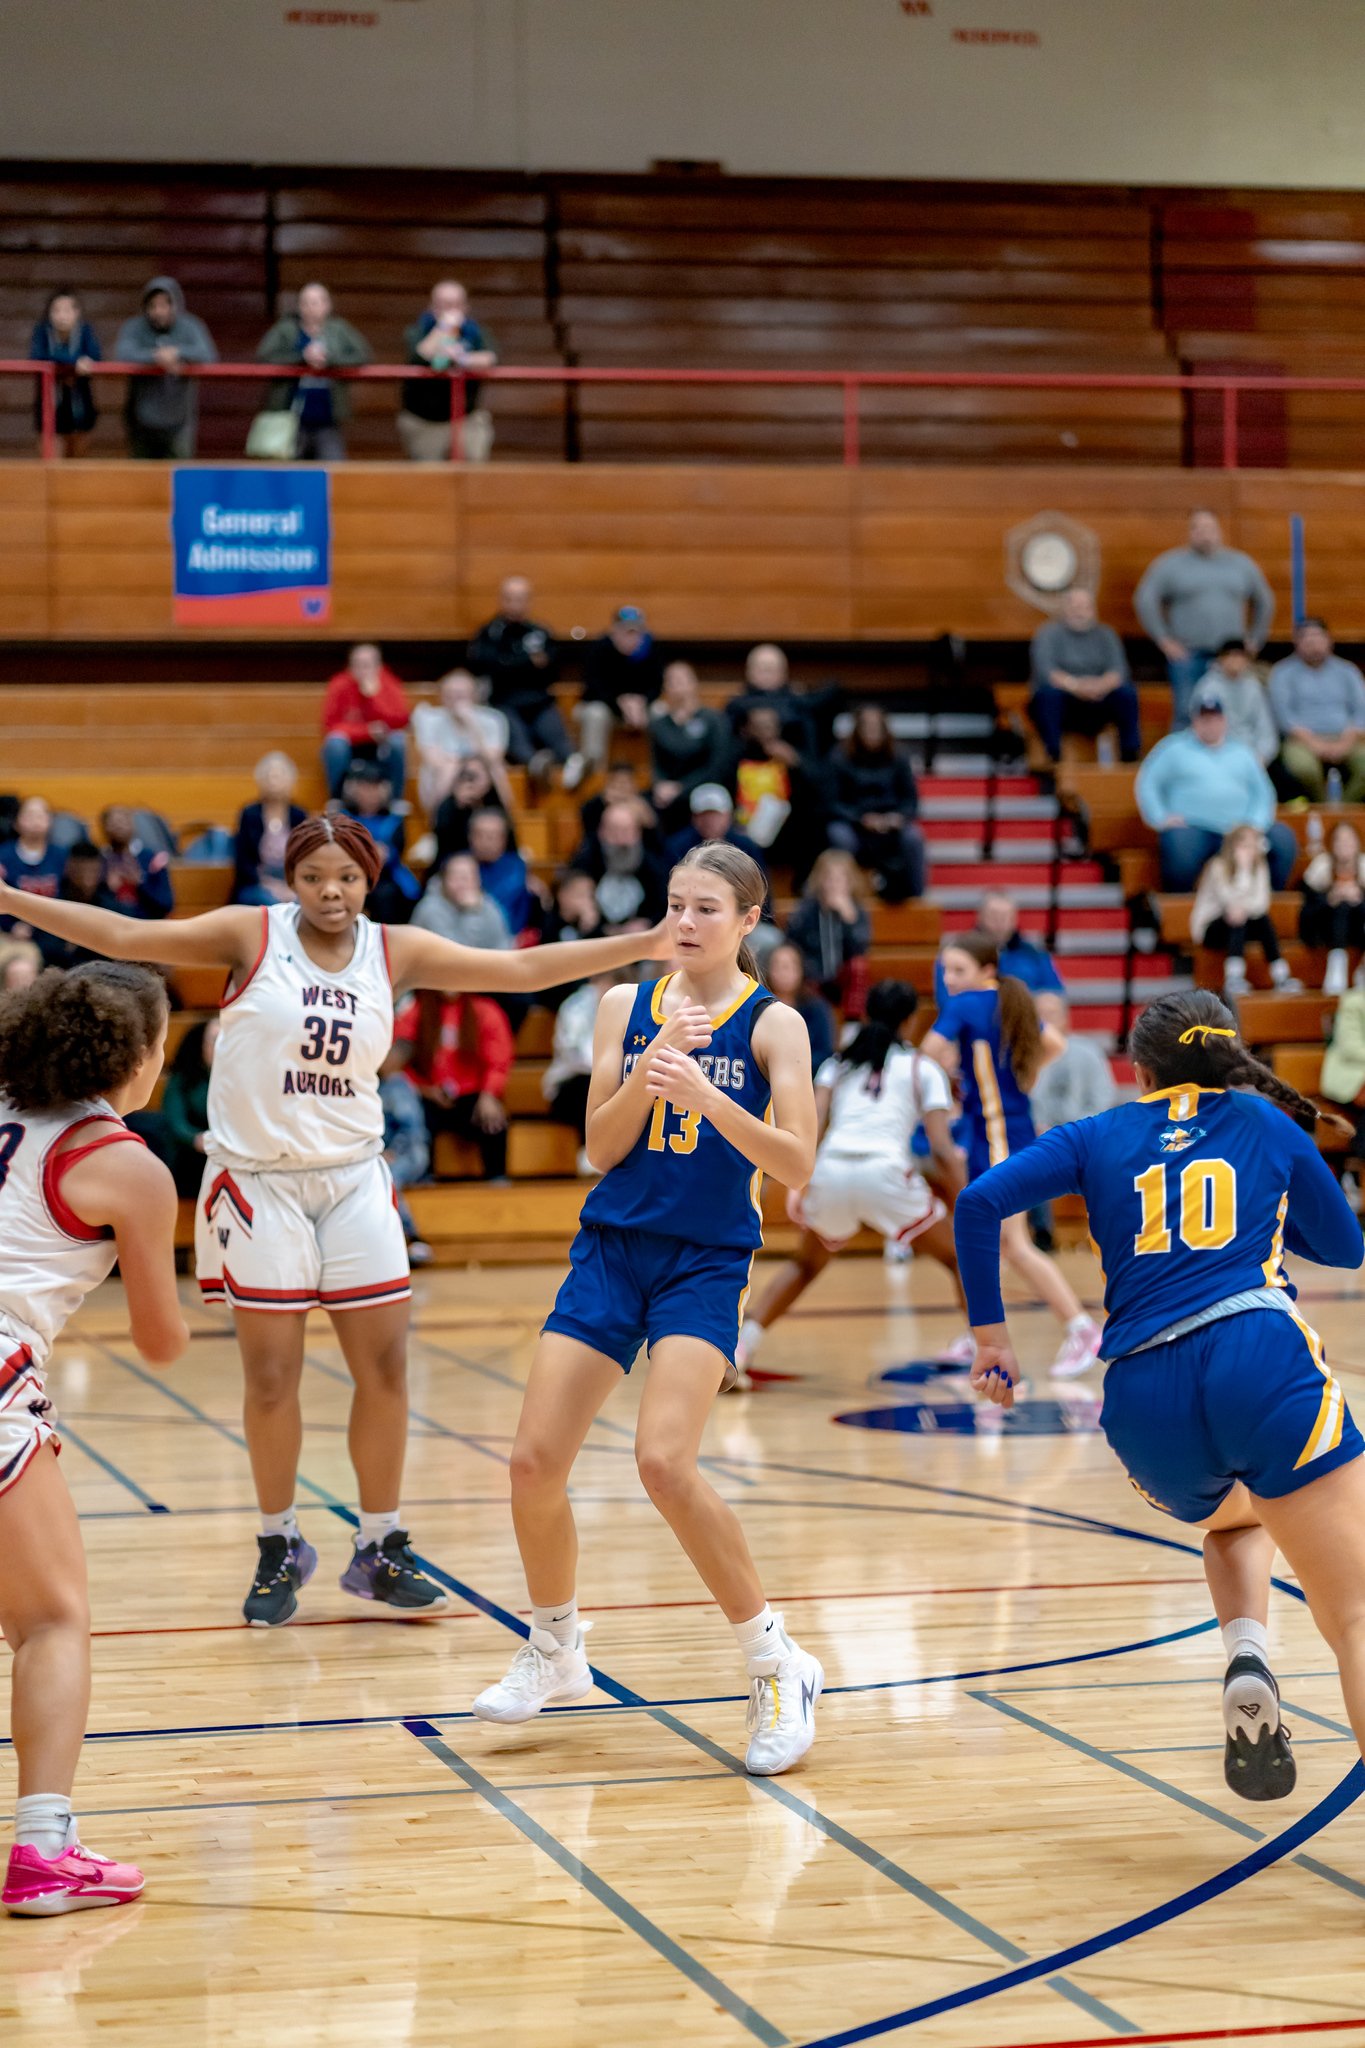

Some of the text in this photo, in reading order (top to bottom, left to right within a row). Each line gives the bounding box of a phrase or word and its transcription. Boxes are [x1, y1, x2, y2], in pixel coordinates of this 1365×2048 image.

[203, 504, 303, 535] General
[188, 542, 318, 572] Admission
[302, 985, 358, 1015] WEST
[301, 1015, 352, 1065] 35
[283, 1070, 356, 1097] AURORA
[647, 1096, 702, 1154] 13
[1134, 1158, 1237, 1256] 10
